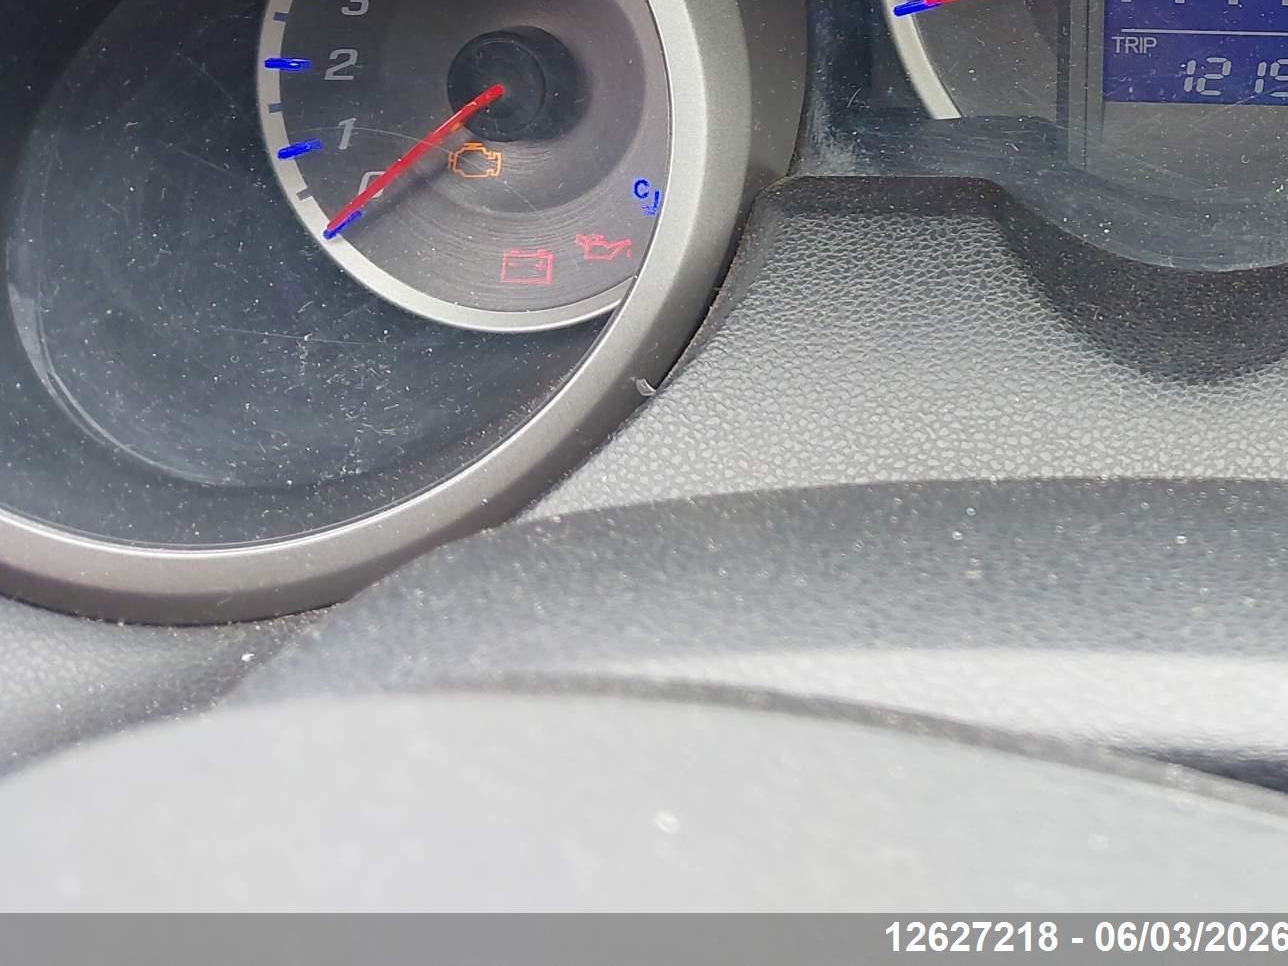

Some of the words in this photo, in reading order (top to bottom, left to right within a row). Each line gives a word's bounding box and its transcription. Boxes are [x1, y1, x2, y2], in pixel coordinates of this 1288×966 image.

[1112, 36, 1157, 54] TRIP
[324, 49, 358, 81] 2
[337, 117, 355, 150] 1
